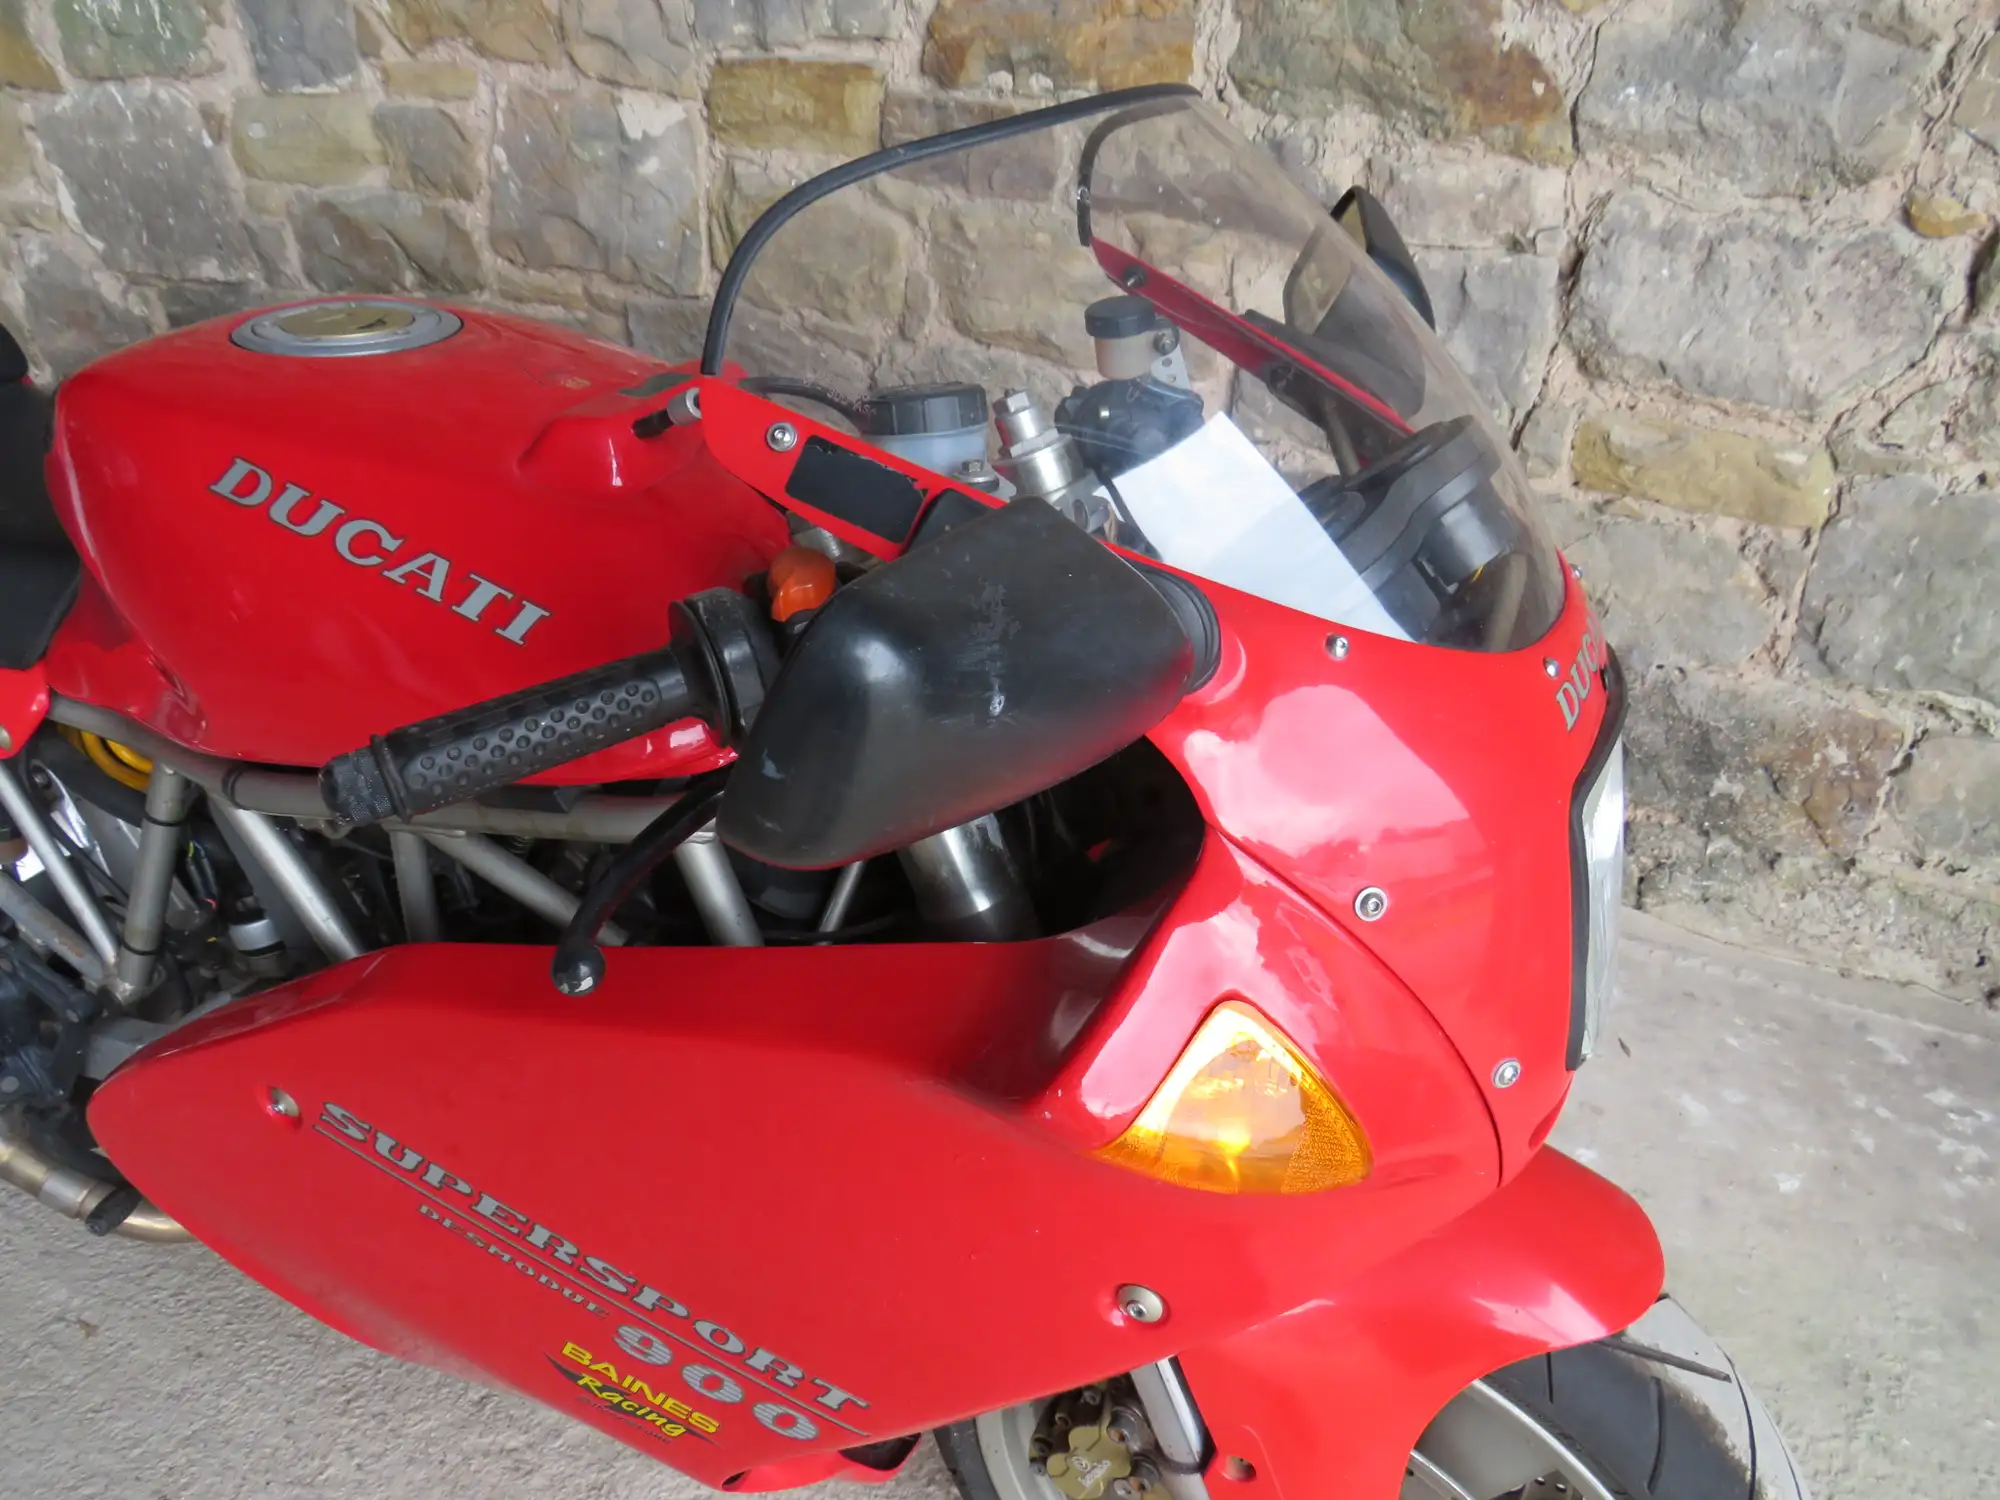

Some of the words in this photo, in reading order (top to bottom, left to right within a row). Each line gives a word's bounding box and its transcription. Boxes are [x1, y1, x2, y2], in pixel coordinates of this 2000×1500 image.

[208, 456, 551, 646] DUCATI
[1556, 614, 1602, 732] DUC
[319, 1101, 871, 1410] SUPERSPORT
[418, 1204, 611, 1319] DESMODUE
[561, 1341, 721, 1434] BAINES
[576, 1372, 687, 1438] Racing
[612, 1325, 820, 1441] 900
